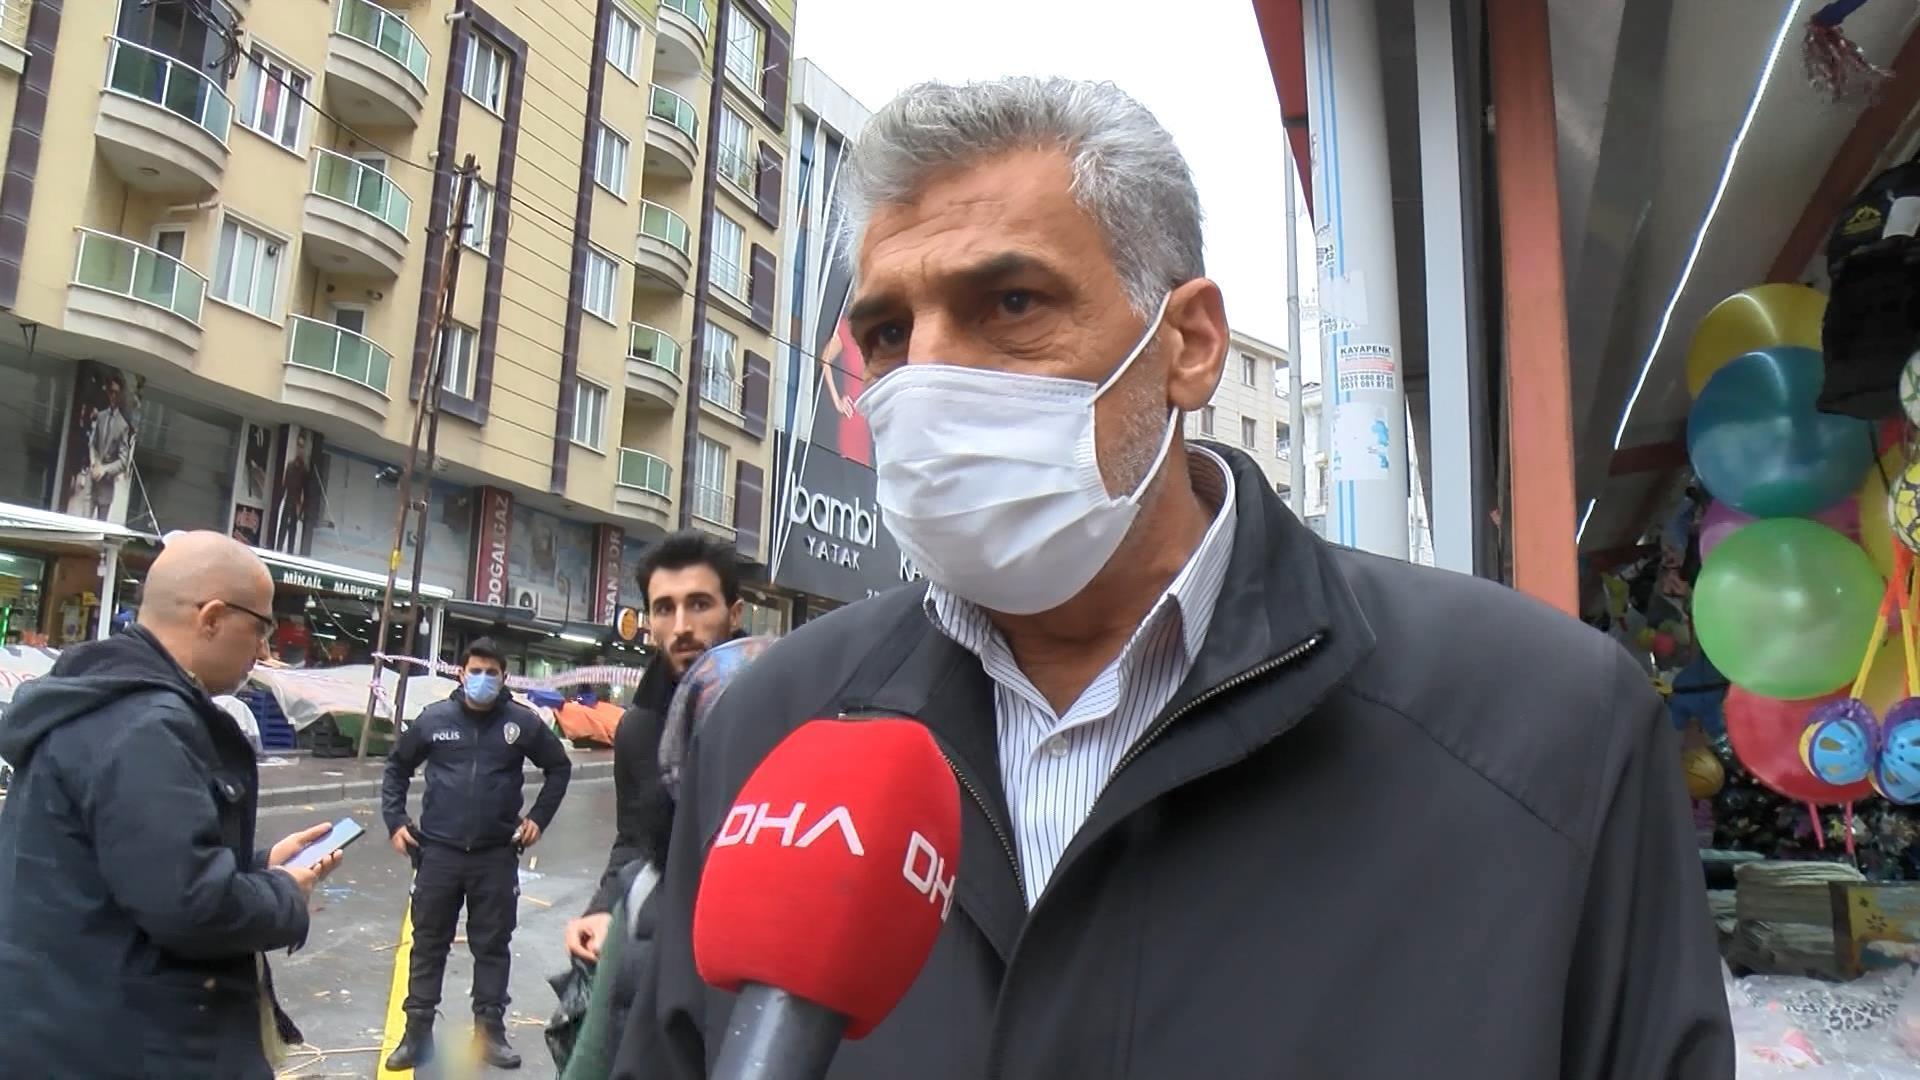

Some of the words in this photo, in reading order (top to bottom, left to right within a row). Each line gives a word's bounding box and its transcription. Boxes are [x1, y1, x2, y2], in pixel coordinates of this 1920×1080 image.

[1340, 345, 1391, 354] KAYAPENK
[790, 471, 878, 549] bambi
[807, 535, 860, 571] YATAK
[333, 581, 378, 598] MARKET
[715, 802, 864, 857] DHA
